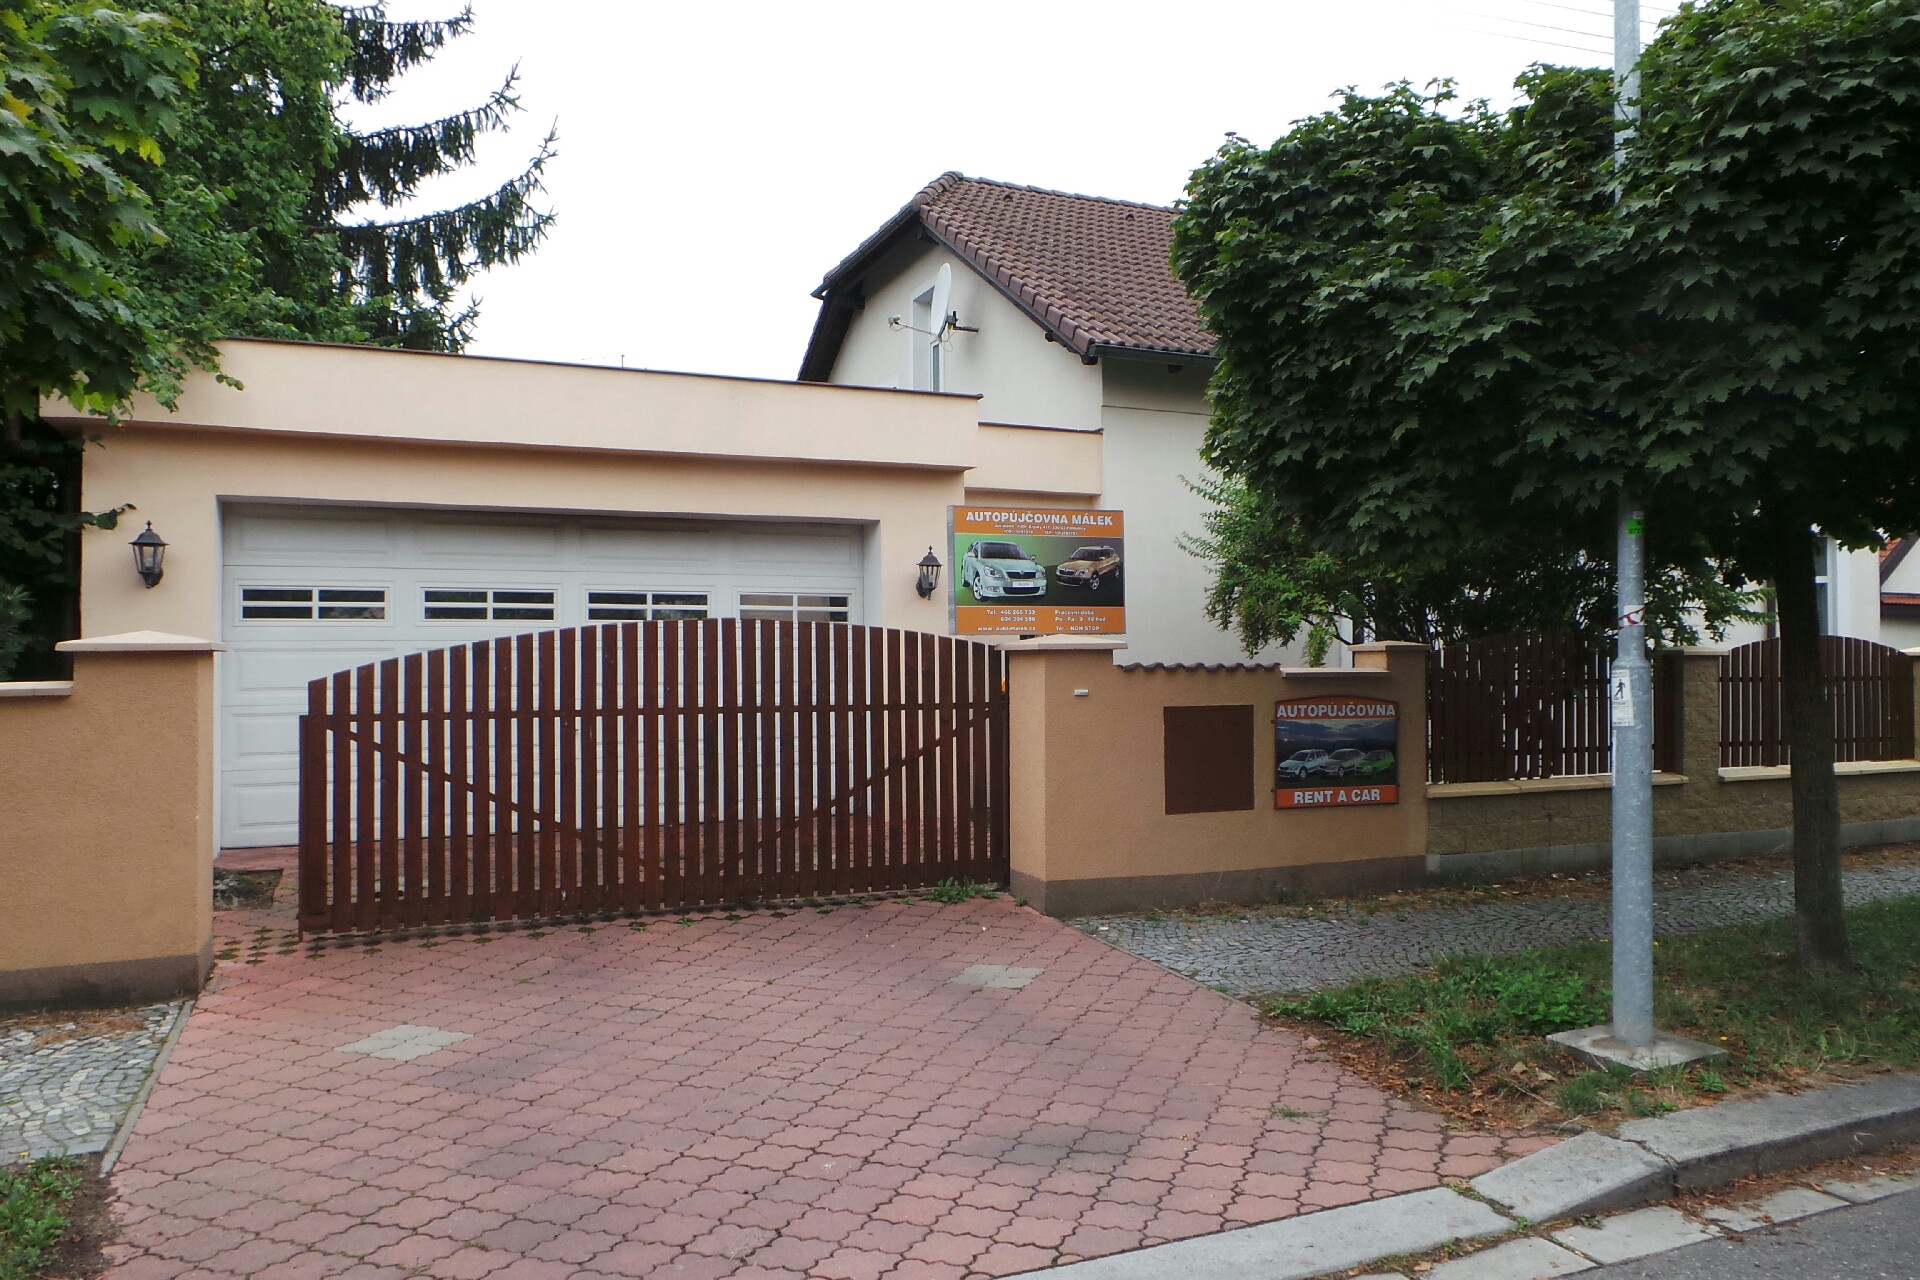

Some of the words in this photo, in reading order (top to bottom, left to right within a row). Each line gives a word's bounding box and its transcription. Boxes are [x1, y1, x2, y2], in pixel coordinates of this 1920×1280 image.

[1072, 512, 1113, 526] MÁLEK
[1294, 790, 1334, 804] RENT
[1338, 790, 1348, 802] A
[1352, 788, 1380, 802] CAR
